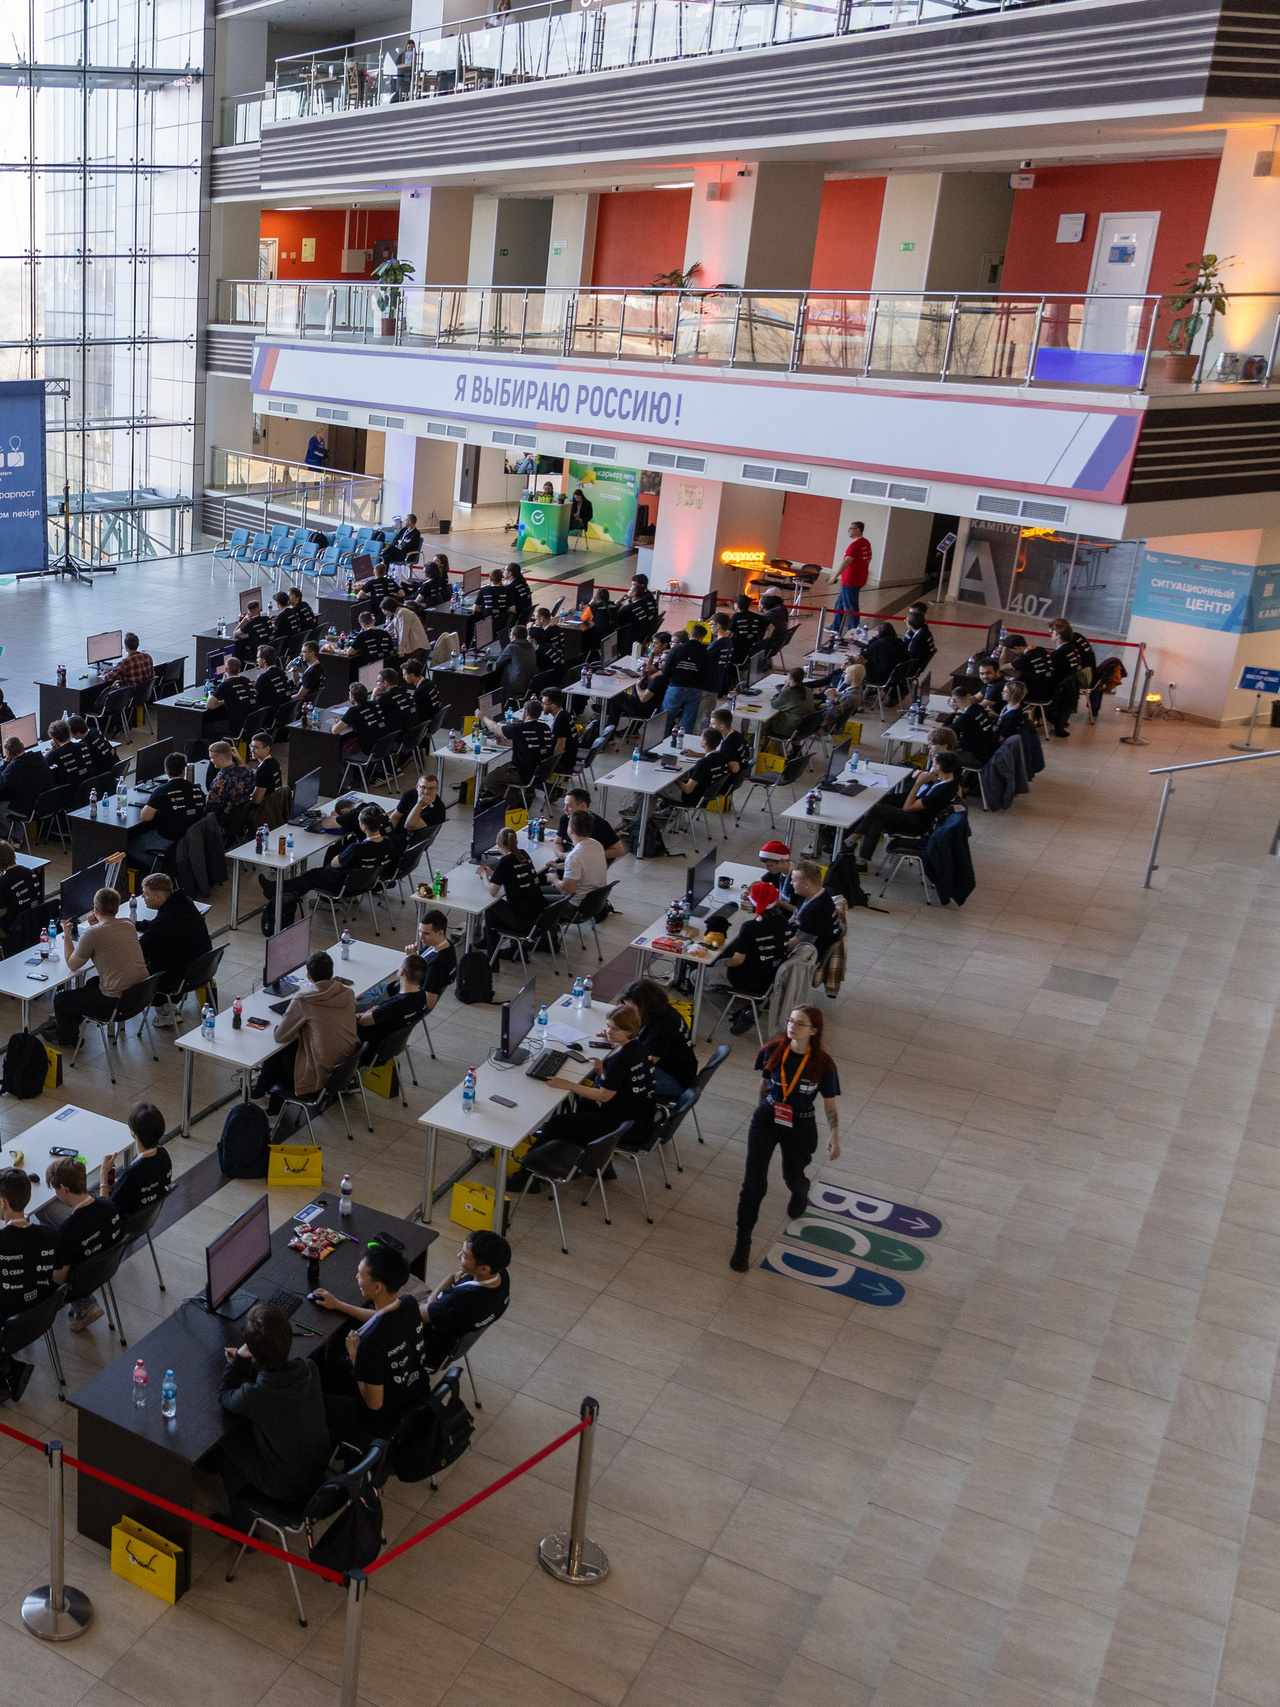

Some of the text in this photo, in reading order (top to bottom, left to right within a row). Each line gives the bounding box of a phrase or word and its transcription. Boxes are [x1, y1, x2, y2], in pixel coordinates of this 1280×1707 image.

[454, 374, 682, 426] Я ВЫБИРАЮ РОССИЮ!
[12, 508, 40, 519] nexign
[970, 519, 1019, 535] КАМПУС
[1150, 578, 1235, 599] СИТУАЦИОННЫЙ
[1010, 593, 1053, 618] 407
[1185, 597, 1232, 615] ЦЕНТР
[808, 1182, 894, 1222] B
[786, 1217, 871, 1257] C
[766, 1242, 856, 1287] D
